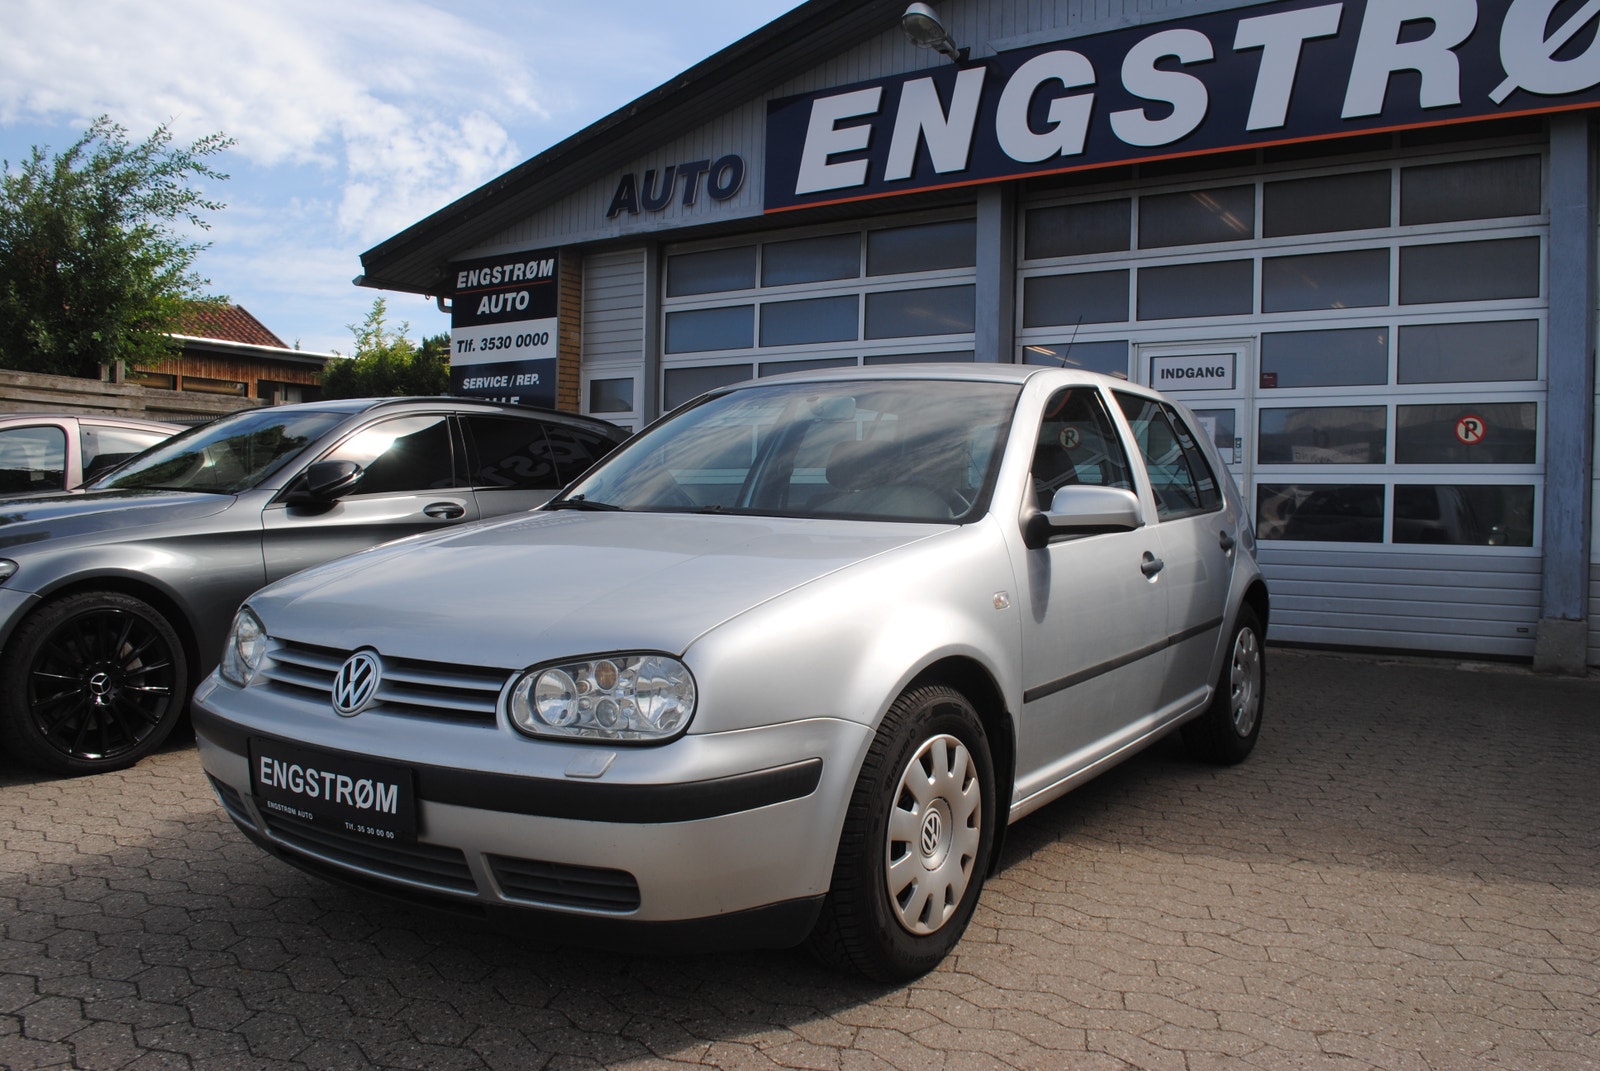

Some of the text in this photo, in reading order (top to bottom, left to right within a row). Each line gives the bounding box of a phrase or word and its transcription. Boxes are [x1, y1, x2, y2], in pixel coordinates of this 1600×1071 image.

[605, 153, 747, 219] AUTO
[456, 258, 555, 289] ENGSTRØM
[476, 290, 530, 315] AUTO
[480, 335, 512, 351] 3530
[515, 331, 550, 348] 0000
[462, 375, 508, 390] SERVICE
[516, 373, 540, 386] REP.
[1160, 366, 1225, 379] INDGANG
[260, 755, 398, 815] ENGSTRØM
[297, 809, 314, 820] AUTO
[357, 824, 366, 833] 35
[366, 826, 375, 835] 30
[376, 828, 385, 837] 00
[385, 830, 395, 839] 00
